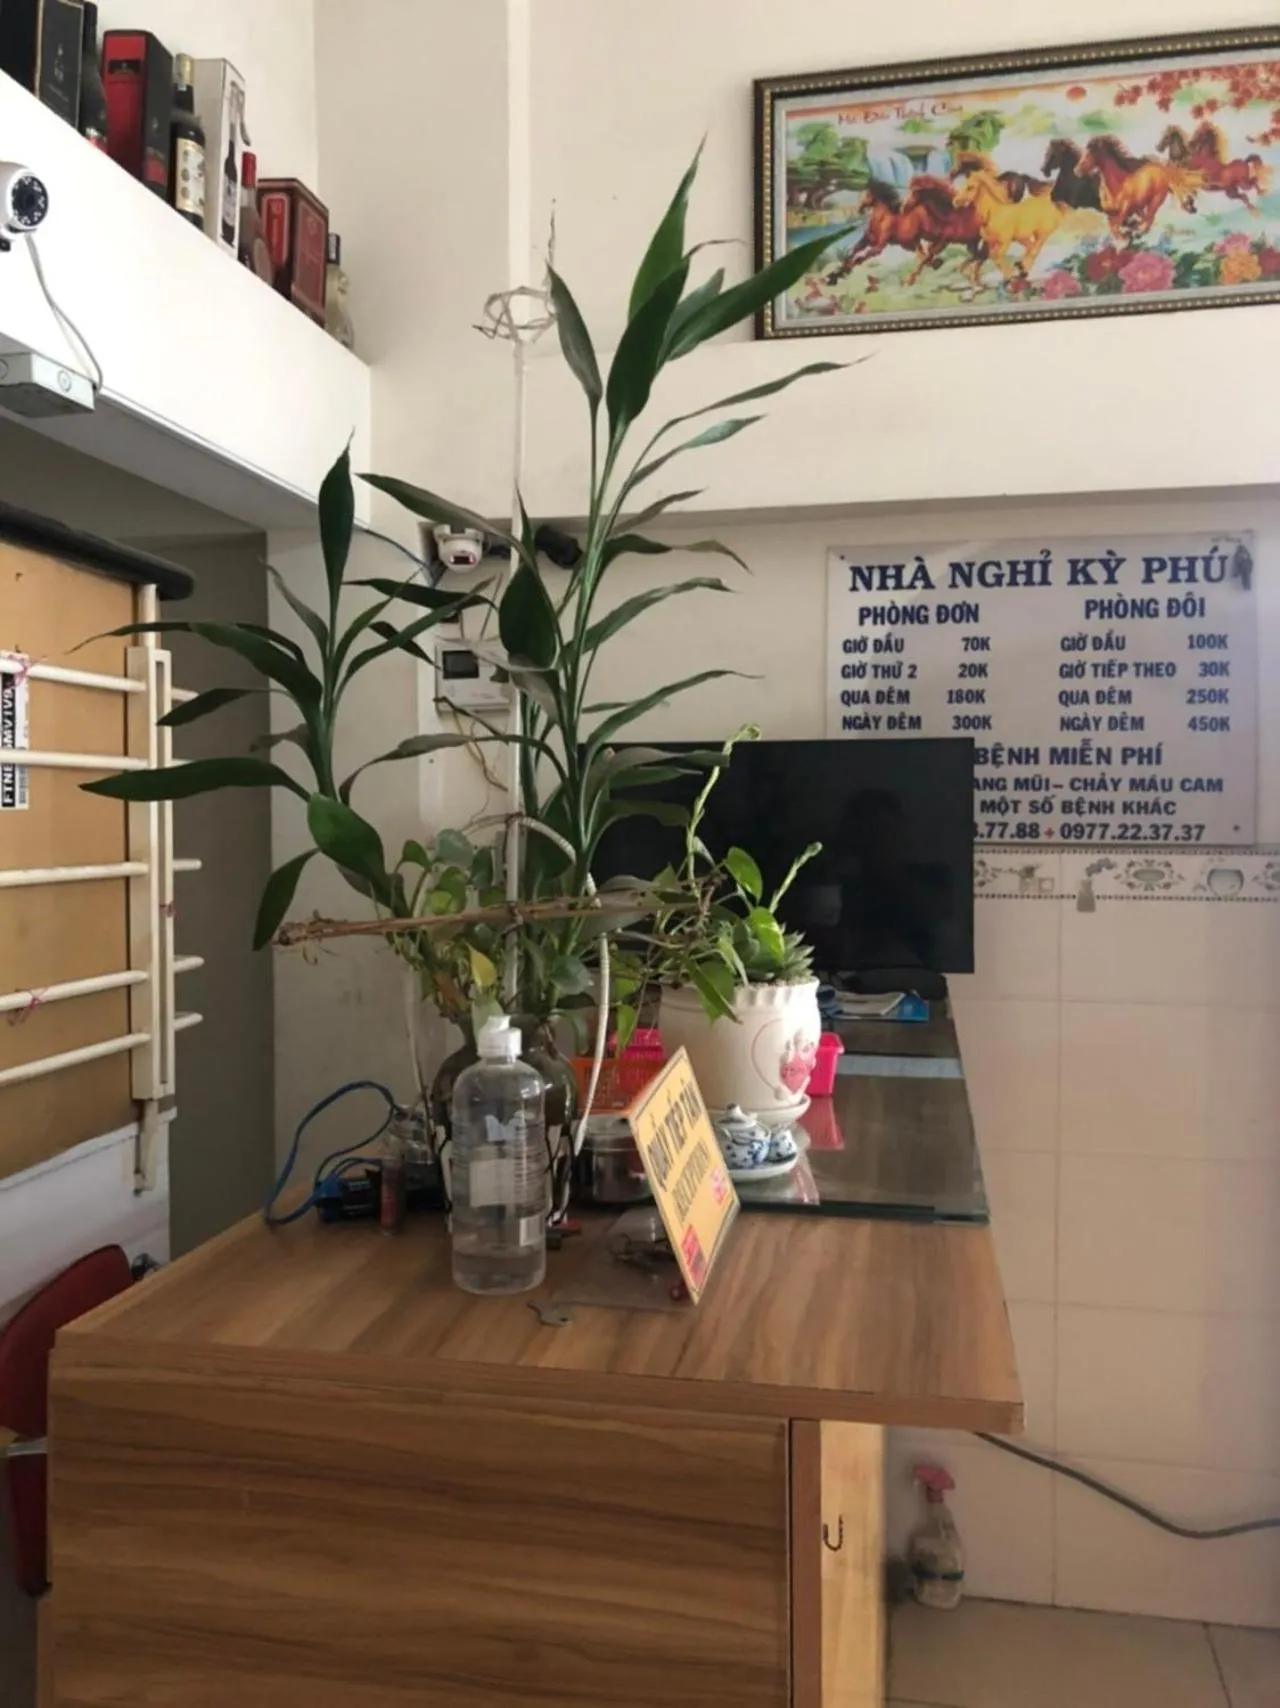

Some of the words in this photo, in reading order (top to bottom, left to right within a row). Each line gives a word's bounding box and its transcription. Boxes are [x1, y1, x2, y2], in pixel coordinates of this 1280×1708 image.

[849, 556, 935, 592] NHÀ
[948, 549, 1053, 589] NGHỈ
[1066, 550, 1127, 586] KỲ
[1141, 545, 1228, 584] PHÚ
[859, 600, 929, 626] PHÒNG
[936, 601, 979, 625] ĐƠN
[1085, 592, 1159, 620] PHÒNG
[1167, 592, 1205, 618] ĐÔI
[961, 636, 991, 652] 70K
[1187, 633, 1228, 650] 100K
[907, 664, 918, 679] 2
[958, 662, 988, 679] 20K
[1090, 658, 1129, 678] TIẾP
[1132, 661, 1177, 678] THEO
[1198, 660, 1230, 678] 30K
[840, 689, 870, 707] QUA
[947, 688, 986, 704] 180K
[1058, 689, 1090, 707] QUA
[1186, 688, 1229, 705] 250K
[842, 712, 882, 731] NGÀY
[951, 714, 992, 731] 300K
[1059, 712, 1102, 731] NGÀY
[1187, 715, 1231, 732] 450K
[973, 742, 1039, 769] BỆNH
[1049, 738, 1112, 766] MIỄN
[1121, 741, 1163, 766] PHÍ
[972, 777, 1007, 791] ANG
[1069, 772, 1122, 792] CHẢY
[1129, 774, 1173, 792] MÁU
[1180, 777, 1223, 792] CAM
[980, 796, 1021, 817] MỘT
[1028, 794, 1056, 814] SỐ
[1061, 796, 1115, 817] BỆNH
[1122, 796, 1177, 815] KHÁC
[1060, 822, 1206, 841] 0977.22.37.37
